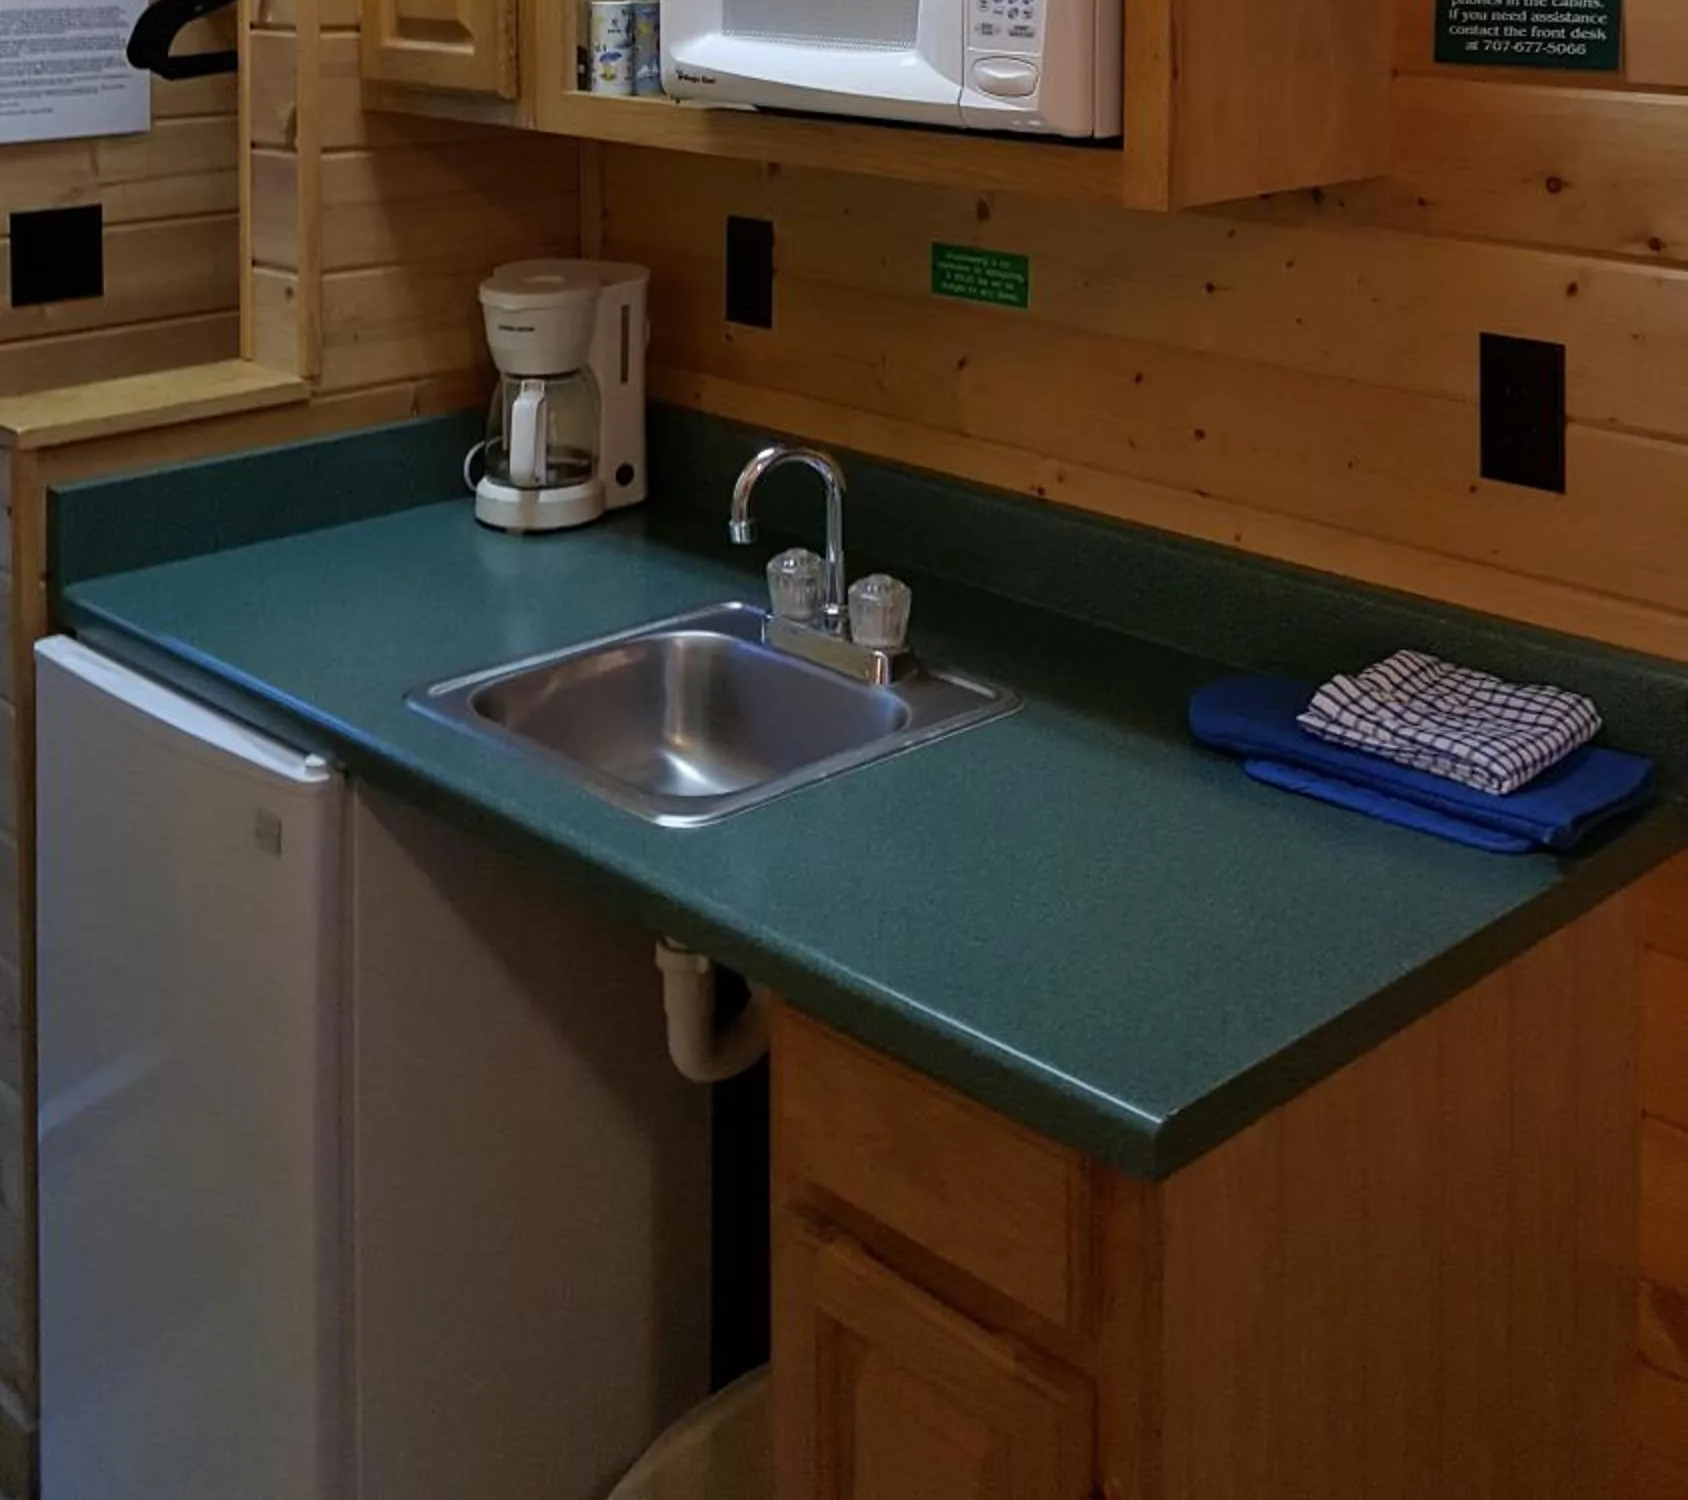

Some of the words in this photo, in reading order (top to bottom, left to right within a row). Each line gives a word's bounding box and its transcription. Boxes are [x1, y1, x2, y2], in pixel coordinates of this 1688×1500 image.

[1461, 11, 1487, 23] you
[1491, 10, 1527, 21] need
[1530, 11, 1608, 24] assistance
[1448, 25, 1499, 36] contact
[1503, 25, 1528, 37] the
[1531, 26, 1566, 38] front
[1570, 28, 1607, 40] desk
[1465, 41, 1479, 51] at
